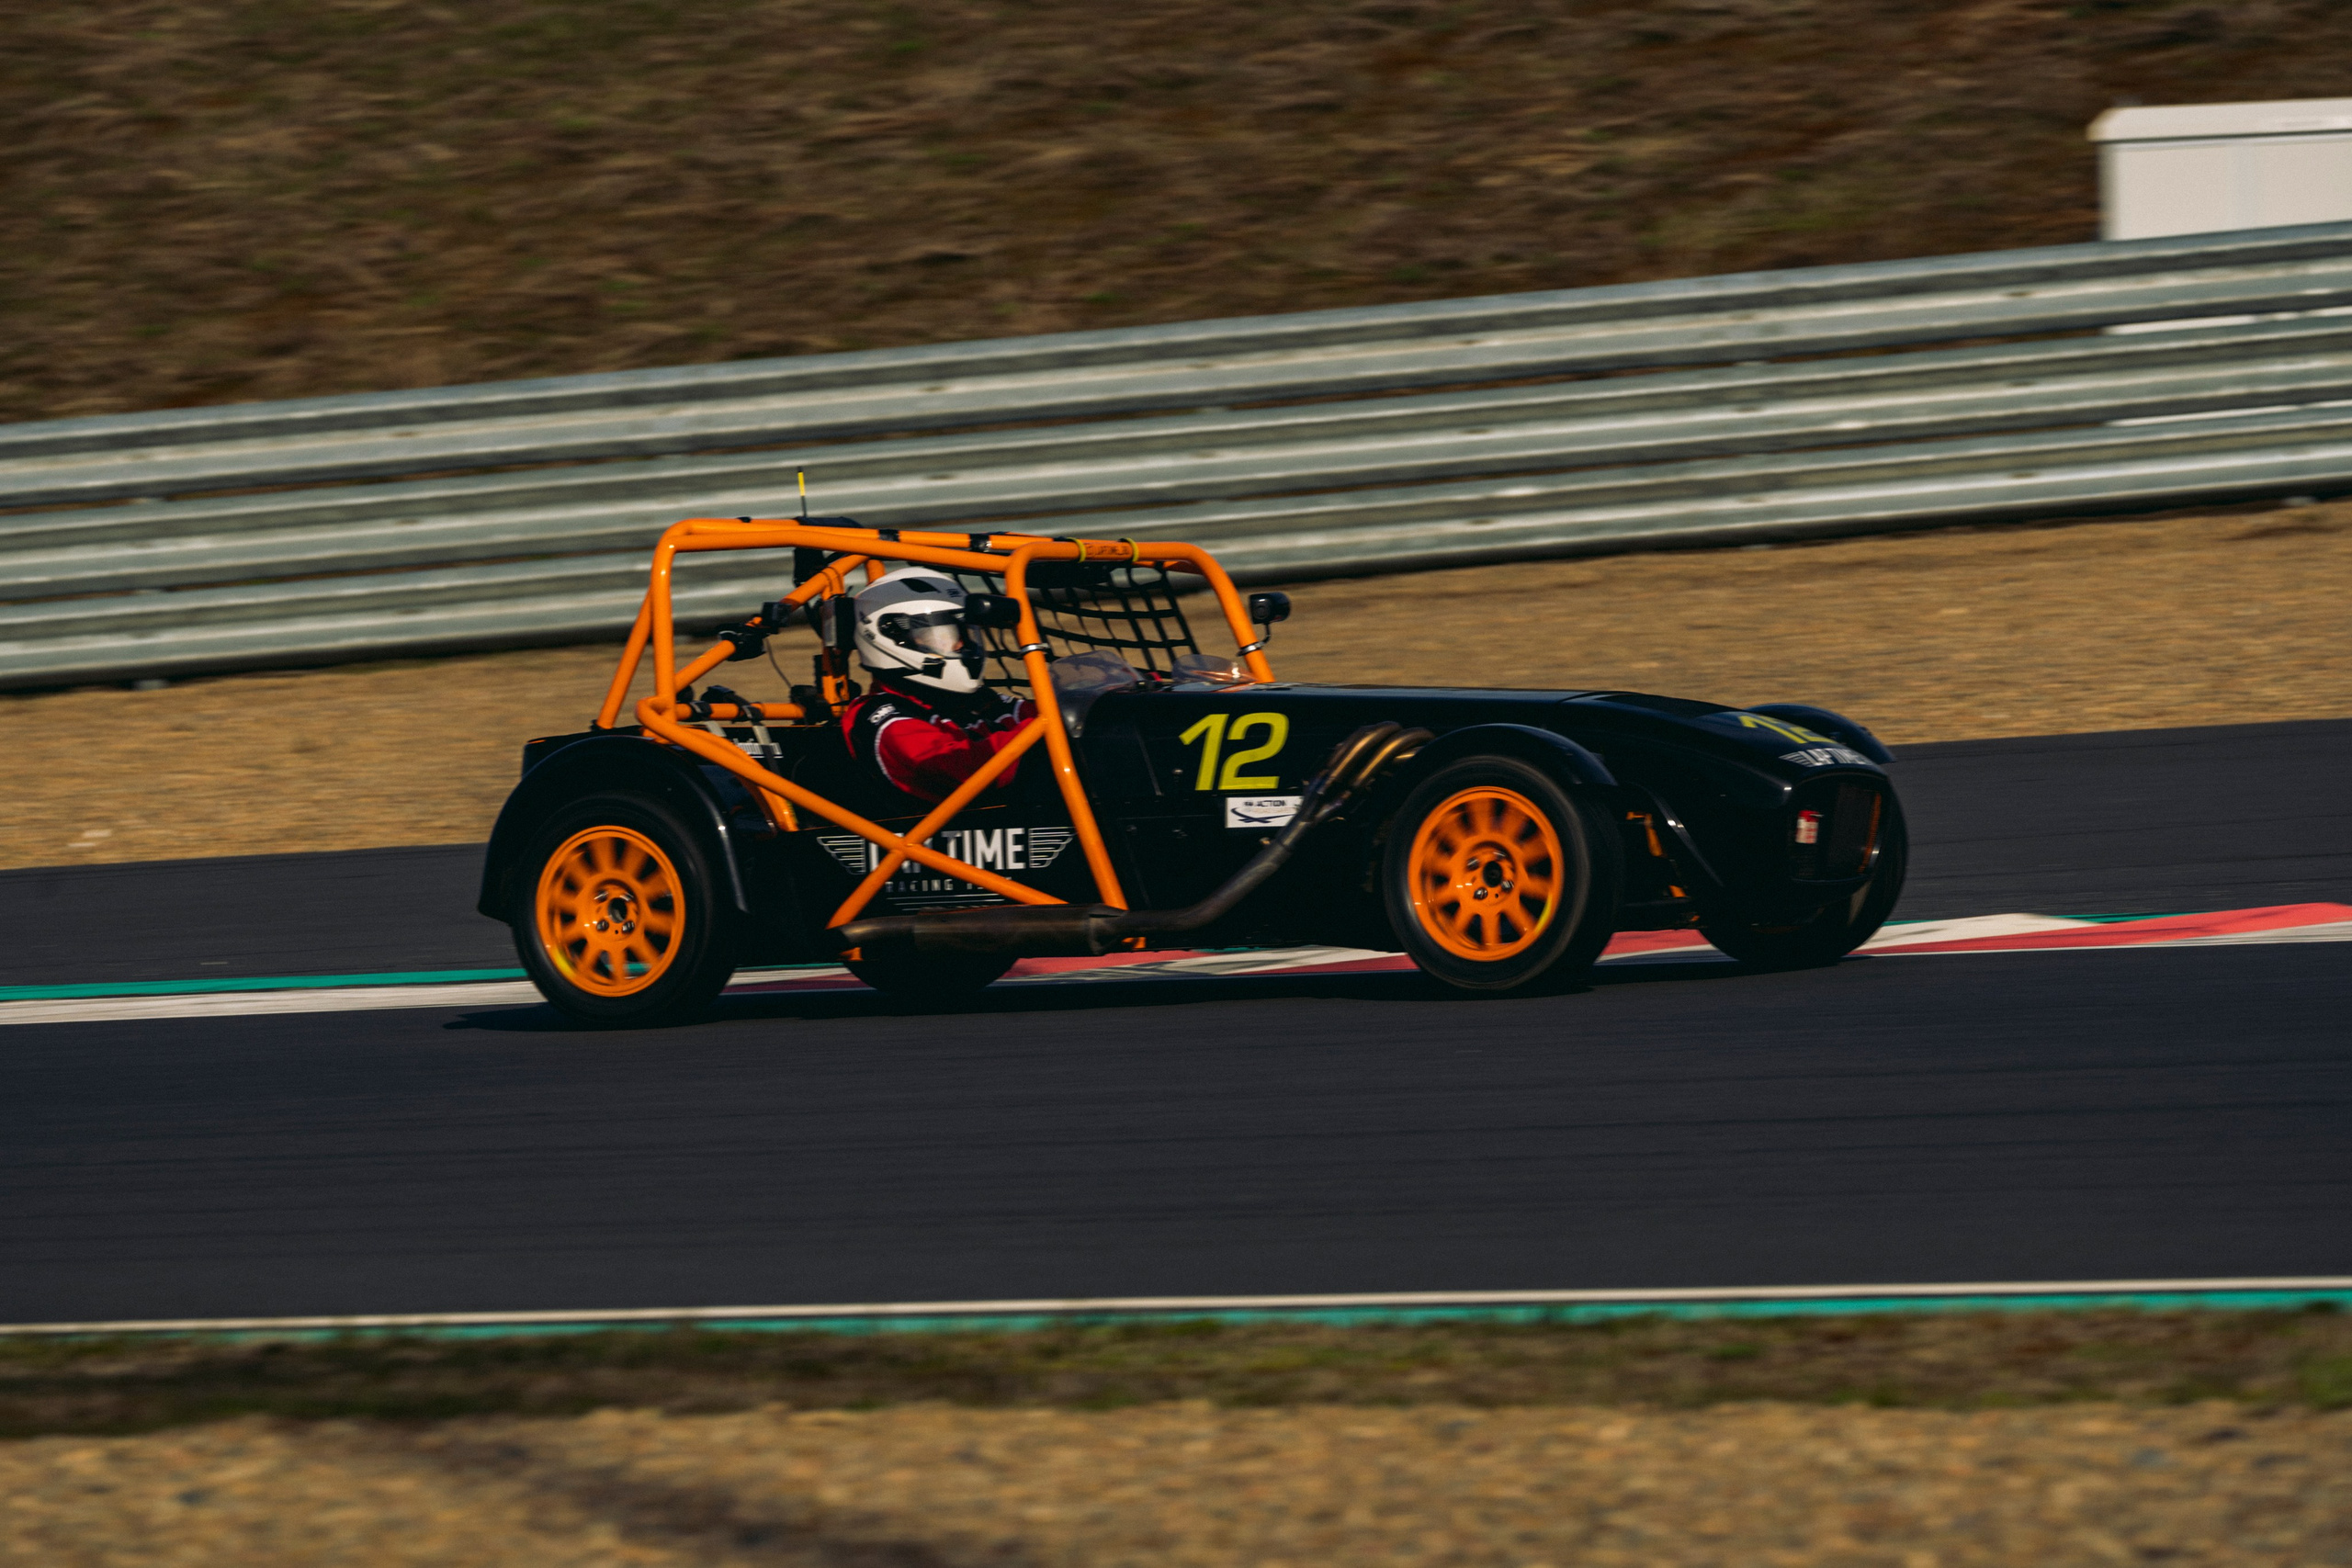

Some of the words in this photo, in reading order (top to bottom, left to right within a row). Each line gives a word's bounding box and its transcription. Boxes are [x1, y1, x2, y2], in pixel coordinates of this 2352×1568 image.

[1179, 712, 1290, 791] 12
[941, 828, 1026, 871] TIME
[885, 878, 955, 893] RACING
